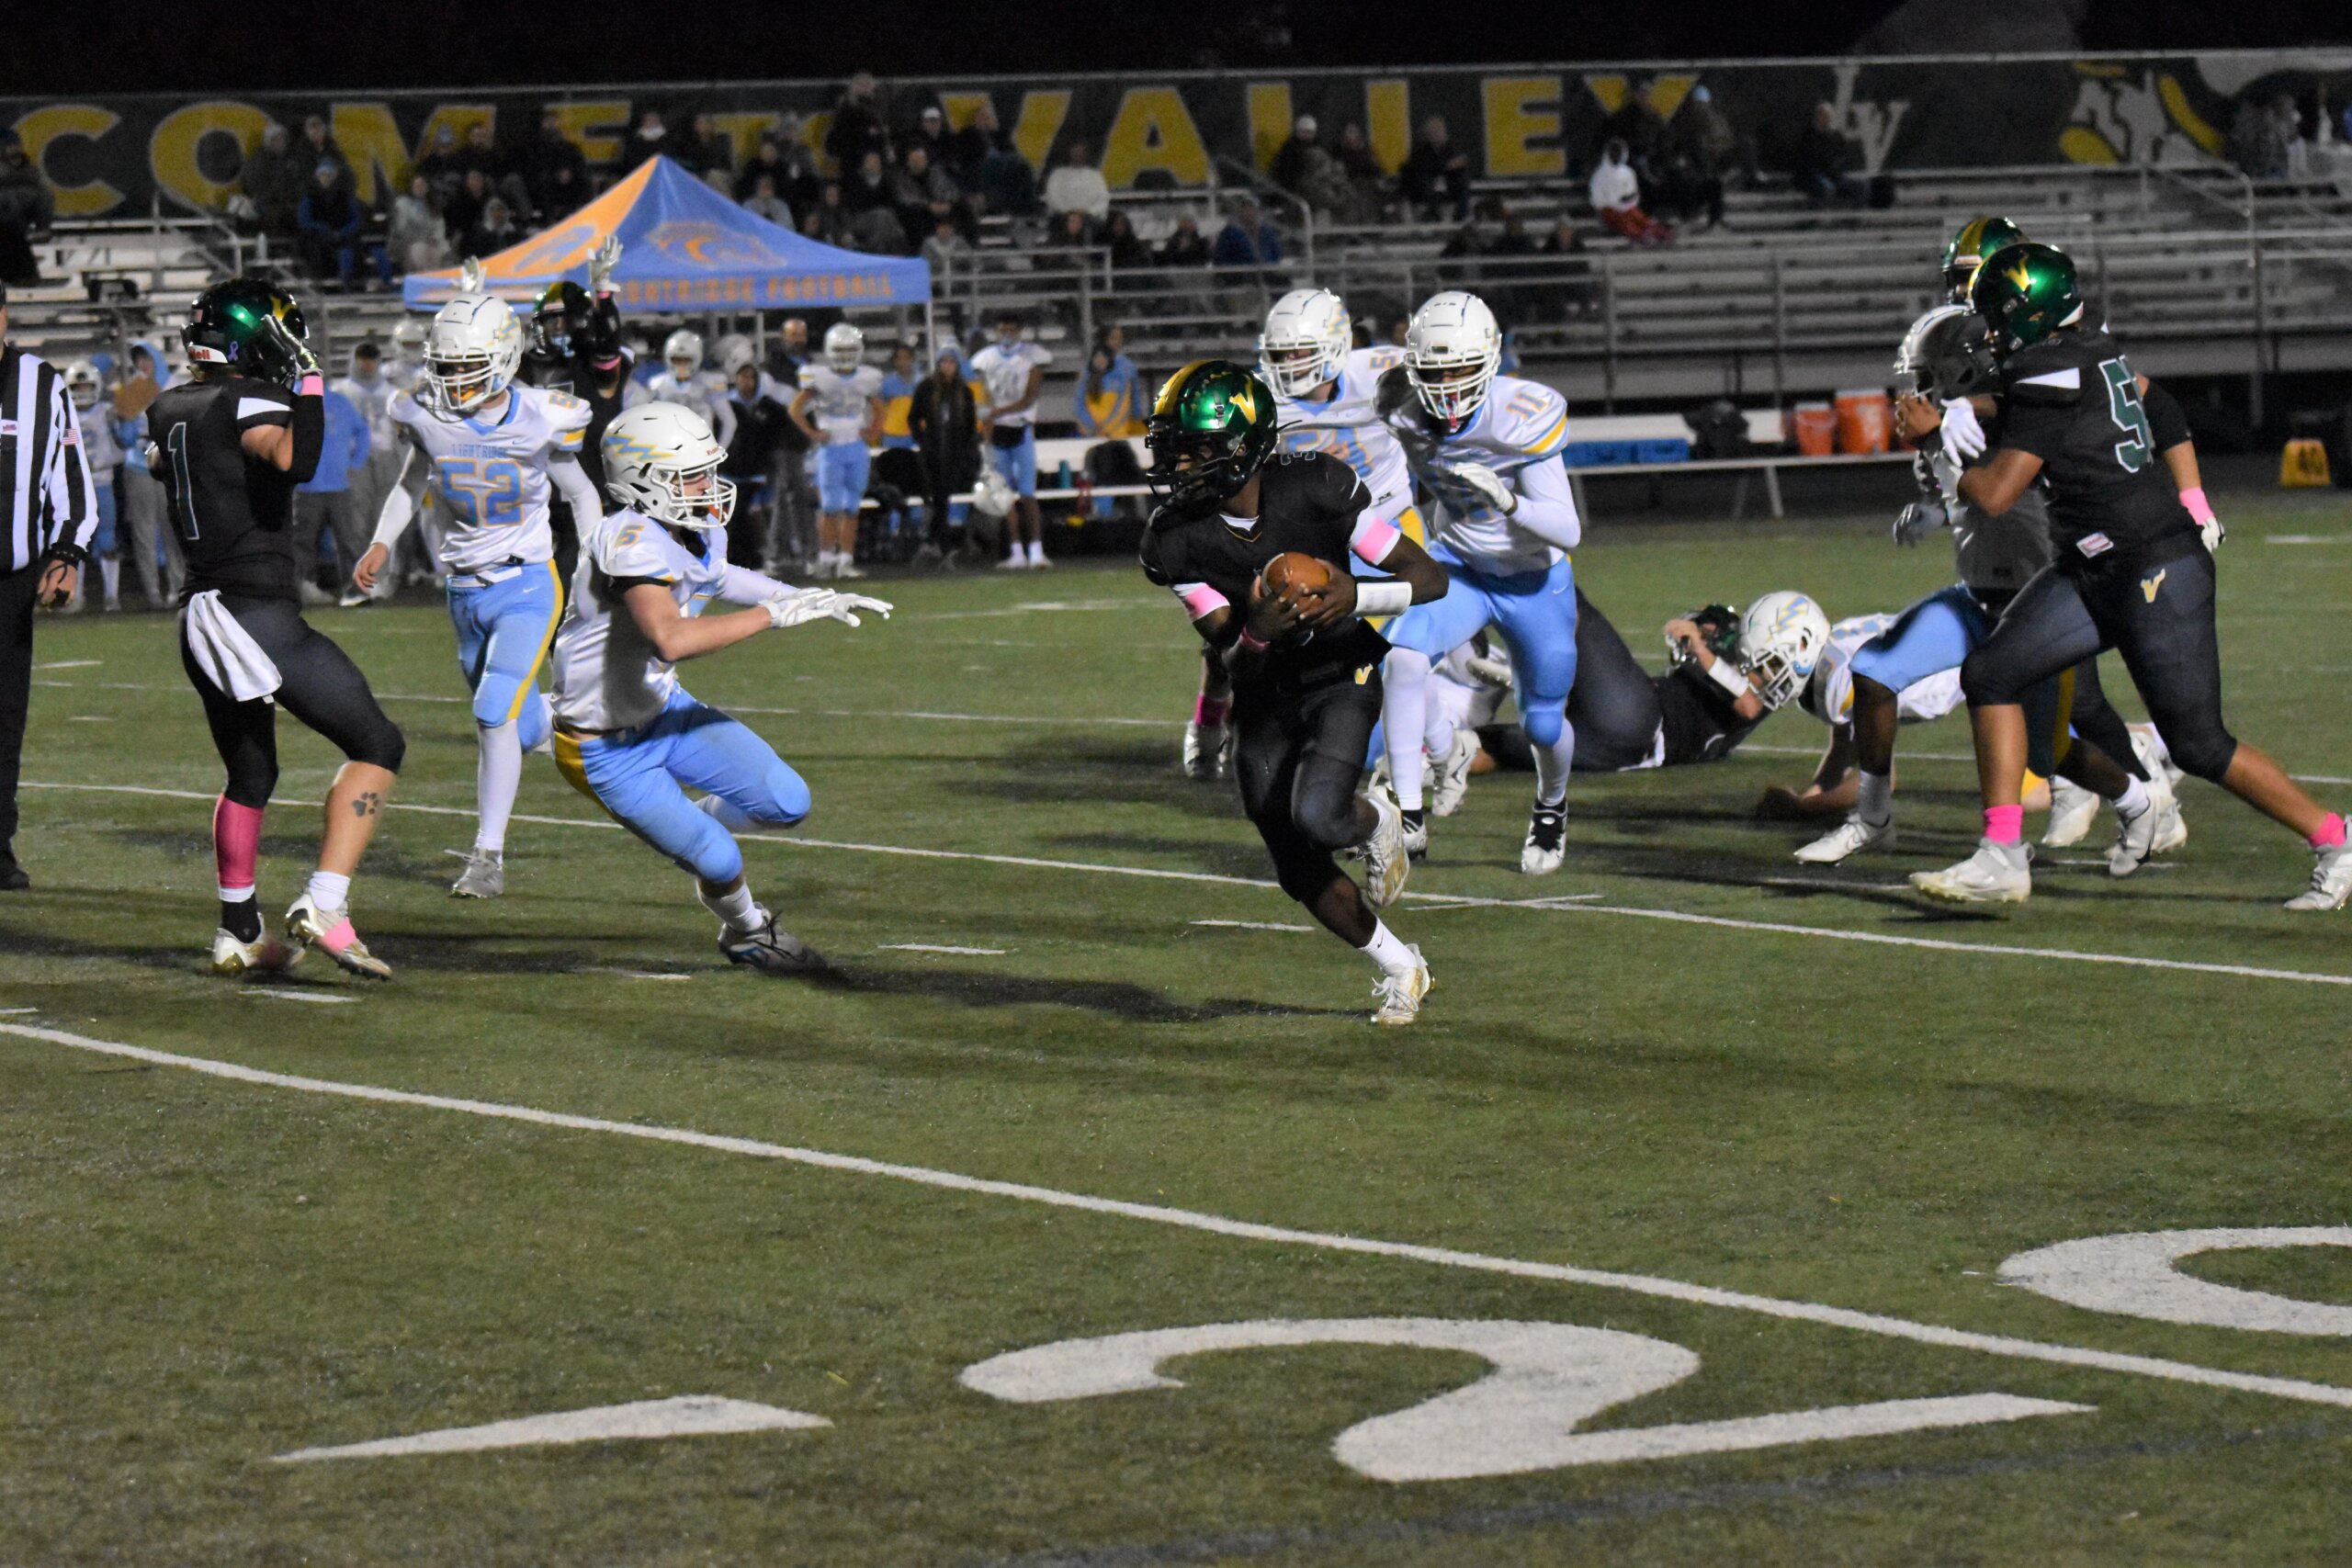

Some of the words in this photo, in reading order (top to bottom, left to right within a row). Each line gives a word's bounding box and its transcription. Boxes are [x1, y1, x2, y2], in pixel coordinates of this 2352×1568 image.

[167, 422, 200, 540] 1
[437, 457, 526, 528] 52
[614, 525, 645, 548] 5
[960, 1318, 2097, 1483] 2
